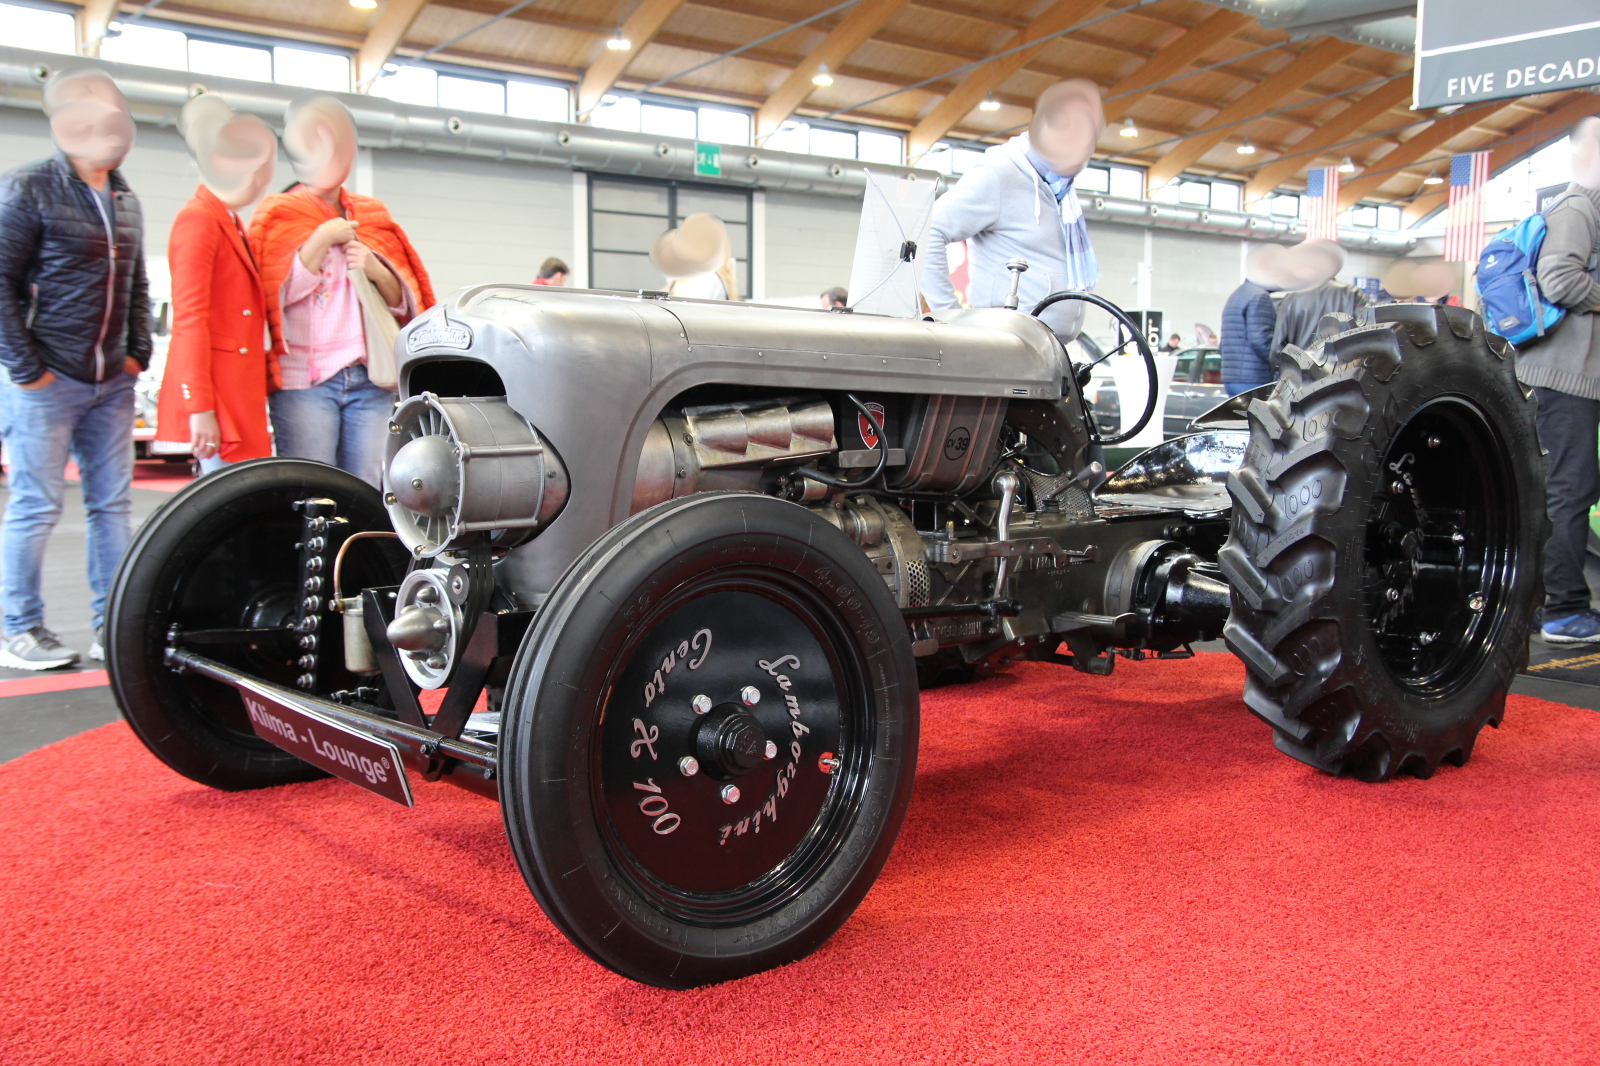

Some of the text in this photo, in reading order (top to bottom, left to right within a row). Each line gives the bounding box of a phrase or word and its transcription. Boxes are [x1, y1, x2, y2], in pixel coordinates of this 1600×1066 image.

[1447, 72, 1495, 98] FIVE
[956, 437, 969, 451] 39
[644, 628, 713, 708] Cento
[245, 696, 299, 745] Klima
[718, 653, 810, 847] Lamborghini
[632, 777, 682, 836] 100
